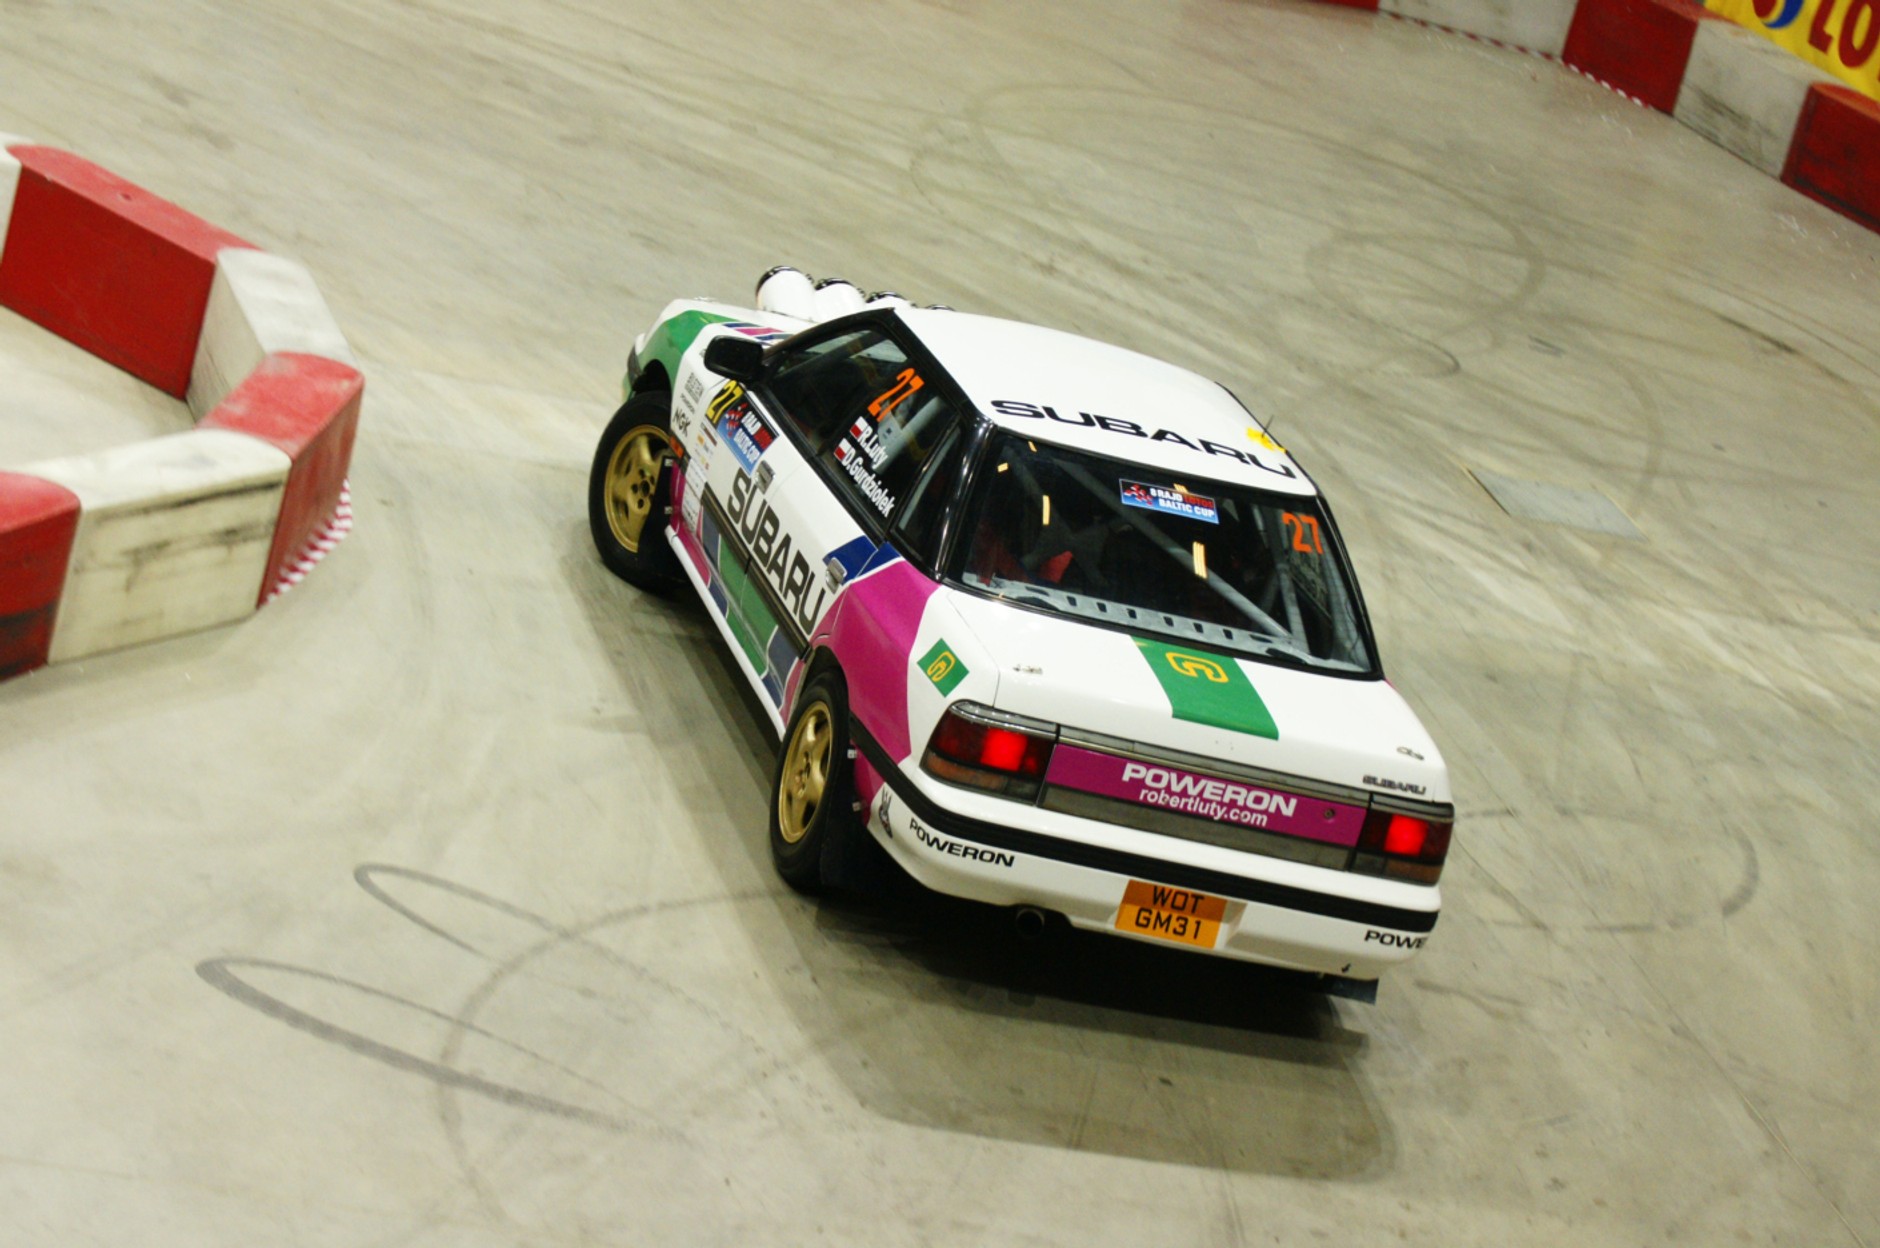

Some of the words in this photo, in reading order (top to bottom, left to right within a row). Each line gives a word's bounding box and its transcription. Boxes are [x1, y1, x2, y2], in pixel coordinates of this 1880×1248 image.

[1807, 0, 1880, 78] LO
[706, 380, 744, 425] 27
[867, 367, 925, 423] 27
[672, 406, 691, 438] NGK
[990, 399, 1297, 480] SUBARU
[857, 425, 889, 470] R.Luty
[1157, 489, 1184, 502] RAJD
[1158, 498, 1194, 513] BALTIC
[1193, 506, 1215, 518] CUP
[727, 467, 826, 636] SUBARU
[1282, 512, 1324, 555] 27
[1122, 763, 1297, 817] POWERON
[1139, 788, 1268, 827] robertluty.com
[909, 817, 1016, 868] POWERON
[1152, 885, 1205, 915] WOT
[1135, 907, 1202, 940] GM31
